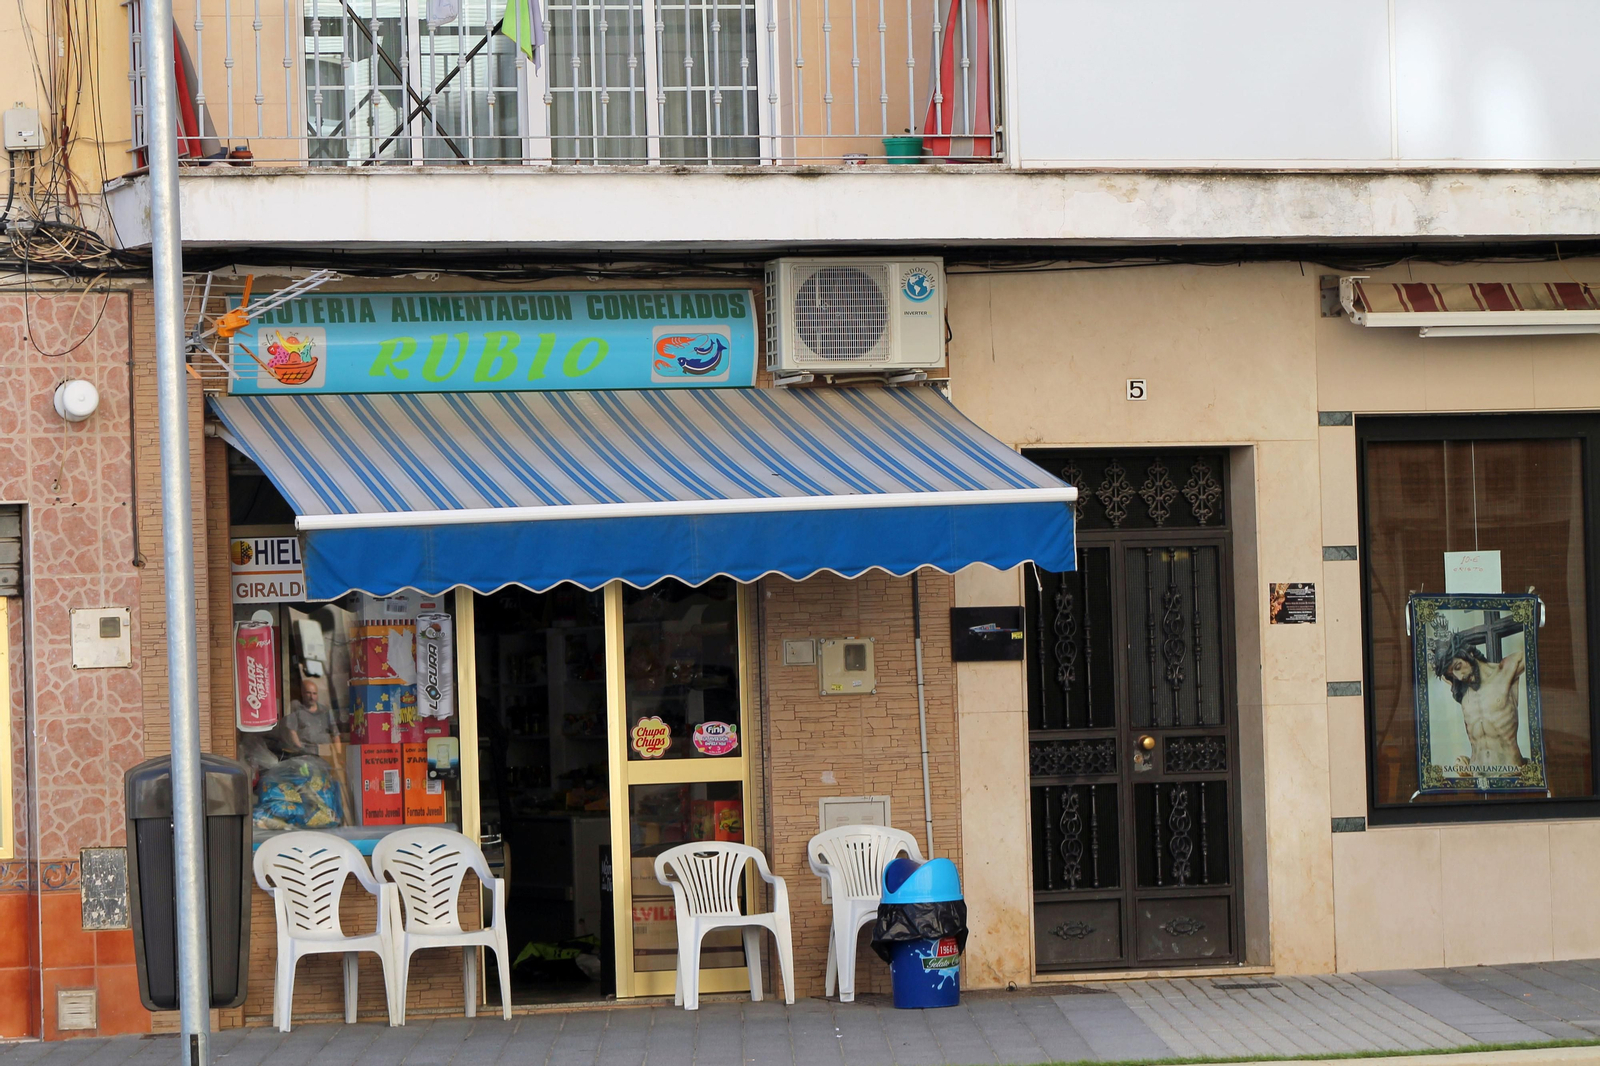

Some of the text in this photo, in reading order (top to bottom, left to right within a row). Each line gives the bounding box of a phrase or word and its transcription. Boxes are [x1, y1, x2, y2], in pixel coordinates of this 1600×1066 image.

[901, 266, 936, 289] MUNDOCLIMA
[391, 295, 573, 323] ALIMENTACION
[586, 293, 747, 320] CONGELADOS
[368, 330, 610, 383] RUBIO
[1129, 380, 1144, 399] 5
[236, 581, 305, 599] GIRALD
[424, 643, 441, 711] LOCURA
[246, 656, 262, 719] LOCURA
[636, 727, 666, 737] Chupa
[635, 737, 666, 751] Chups
[365, 757, 399, 765] KETCHUP
[366, 807, 401, 819] Formato Juvenil
[406, 806, 443, 817] Formato Juvenil
[927, 958, 950, 969] Gelato
